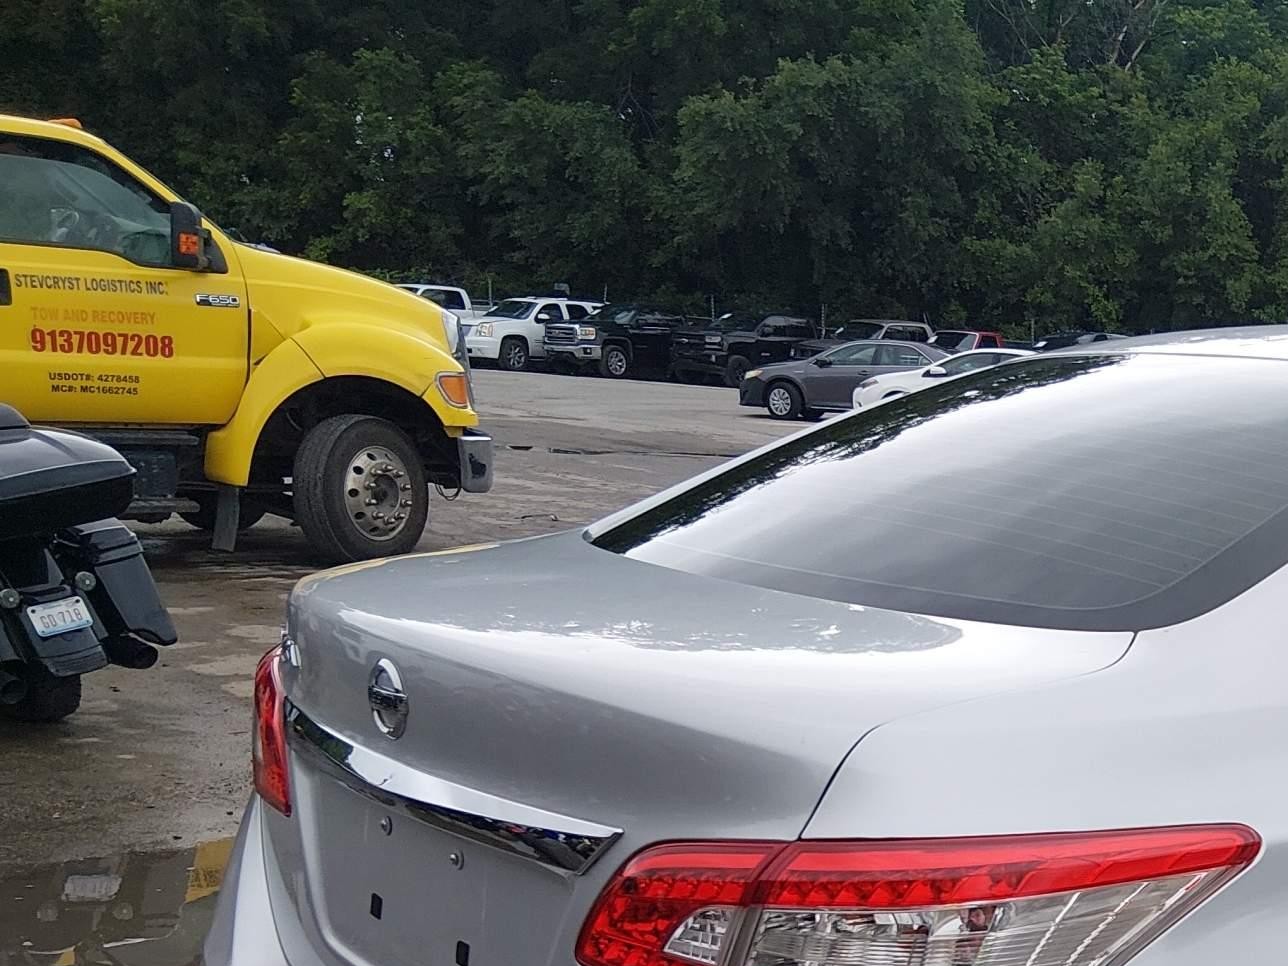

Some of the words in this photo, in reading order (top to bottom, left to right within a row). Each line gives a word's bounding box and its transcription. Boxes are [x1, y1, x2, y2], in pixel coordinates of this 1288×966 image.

[15, 274, 81, 290] STEVCRYST
[85, 278, 142, 294] LOGISTICS
[31, 307, 58, 321] TOW
[64, 310, 88, 322] AND
[92, 310, 155, 325] RECOVERY
[31, 328, 173, 358] 9137097208
[49, 372, 95, 382] USDOT#:
[97, 374, 140, 384] 4278458
[51, 385, 77, 393] MC#:
[80, 385, 138, 395] MC1662745
